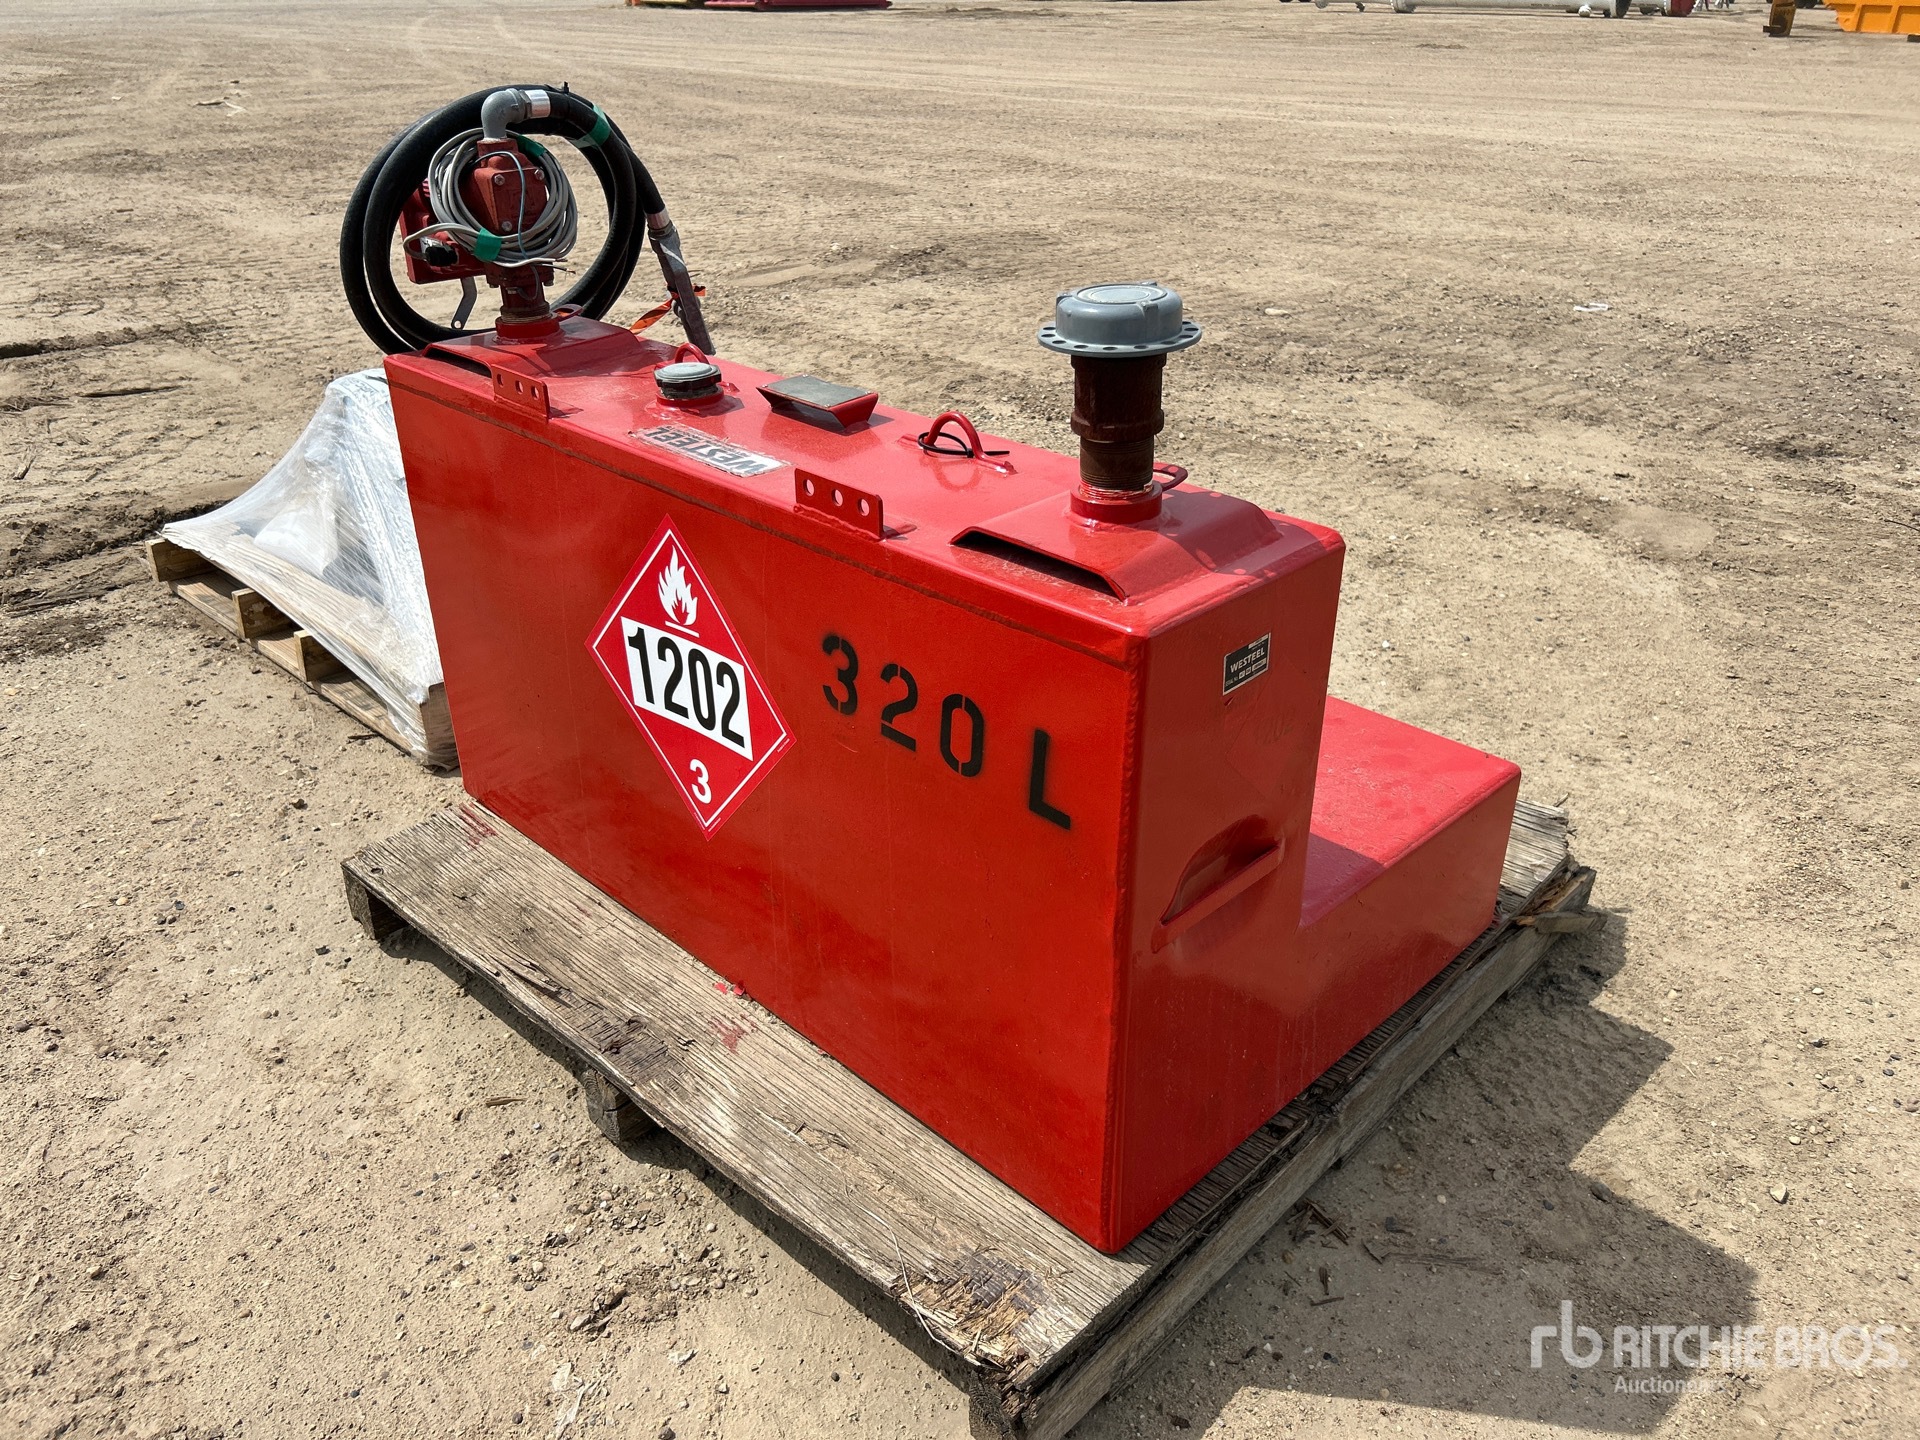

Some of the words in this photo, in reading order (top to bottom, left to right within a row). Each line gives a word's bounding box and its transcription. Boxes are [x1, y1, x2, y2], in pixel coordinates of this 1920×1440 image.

[644, 426, 769, 473] WESTEEL
[1230, 647, 1265, 673] WESTEEL
[628, 628, 746, 749] 1202
[821, 634, 985, 777] 320
[1028, 729, 1071, 830] L
[690, 759, 712, 804] 3
